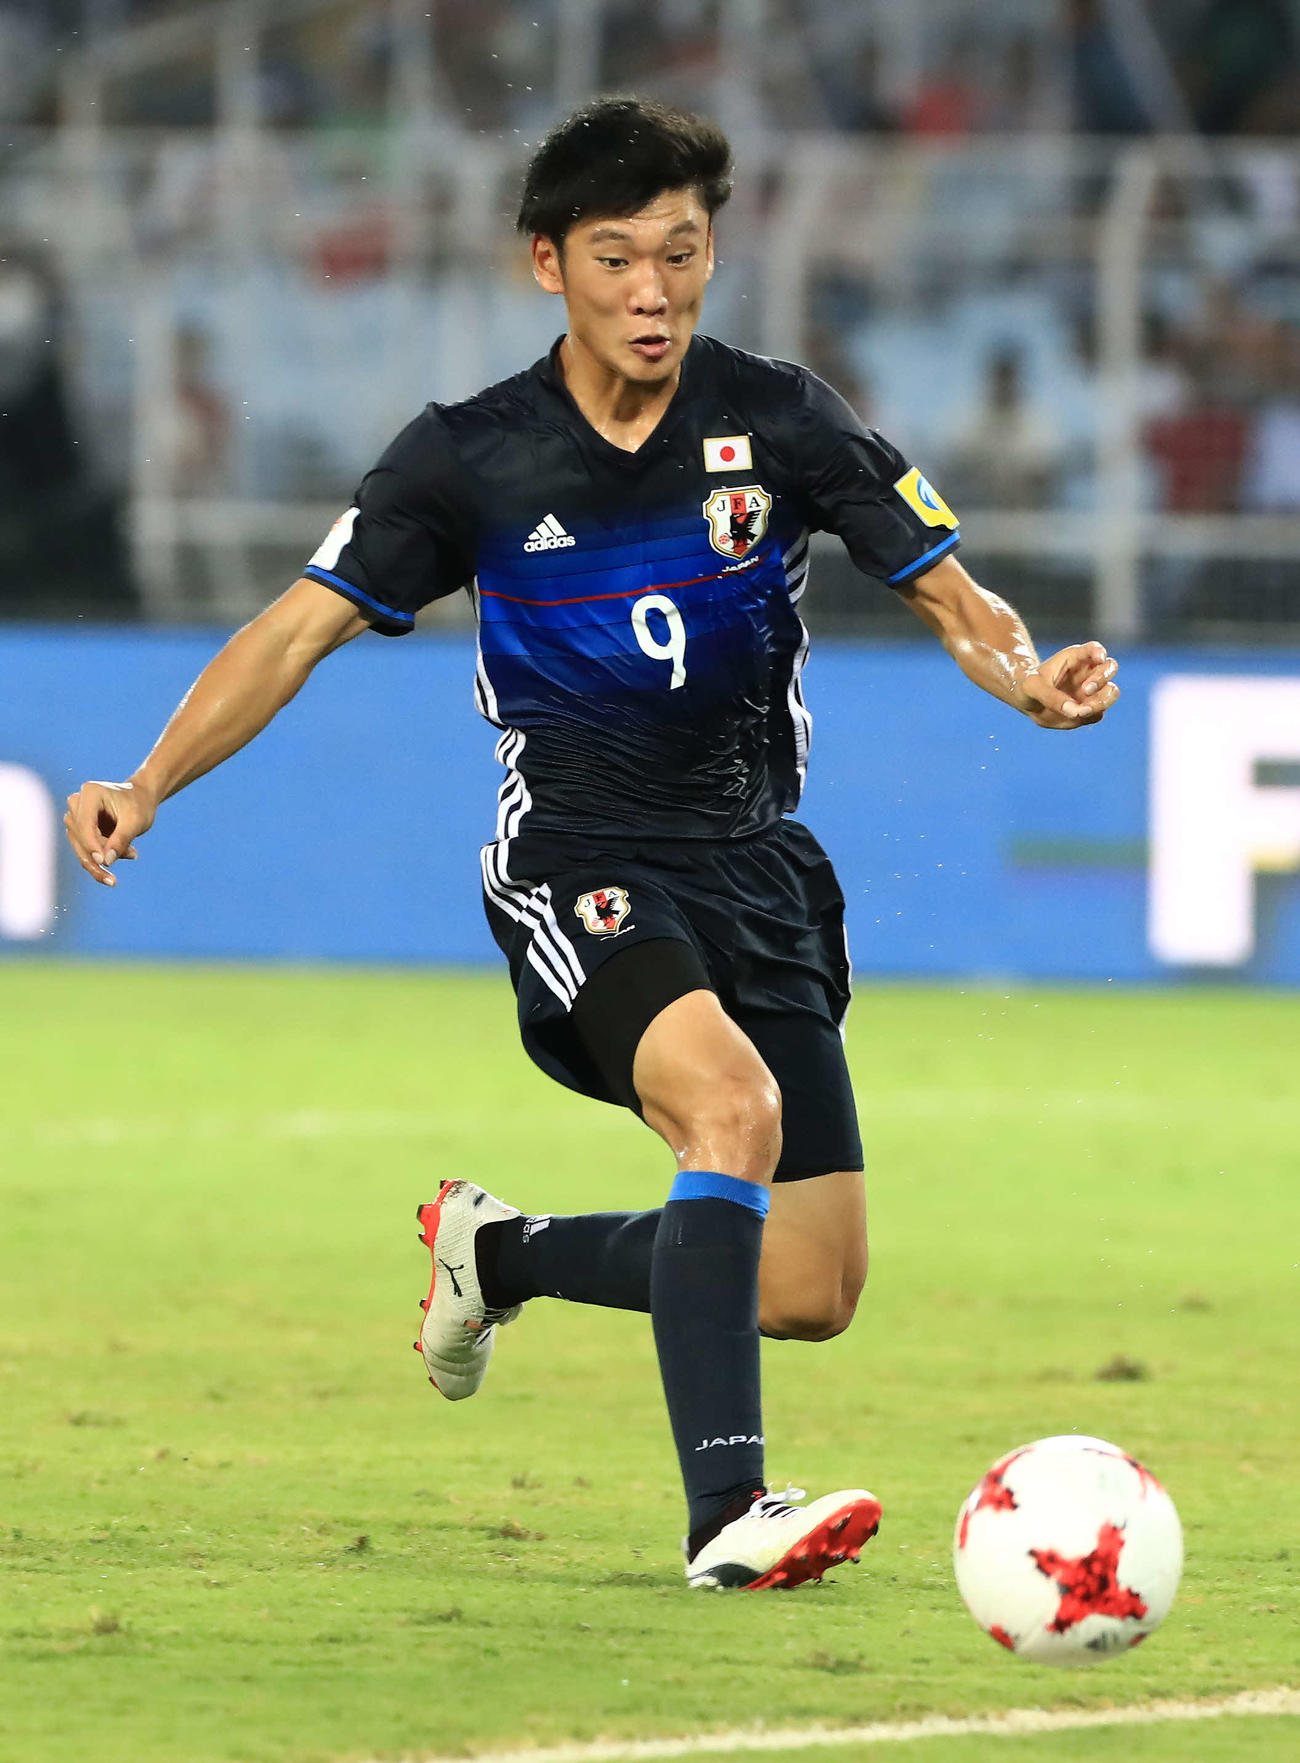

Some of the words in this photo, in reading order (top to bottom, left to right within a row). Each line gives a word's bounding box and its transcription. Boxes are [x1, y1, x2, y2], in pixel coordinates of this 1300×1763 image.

[717, 496, 761, 512] JFA
[523, 535, 576, 552] adidas
[631, 594, 686, 690] 9
